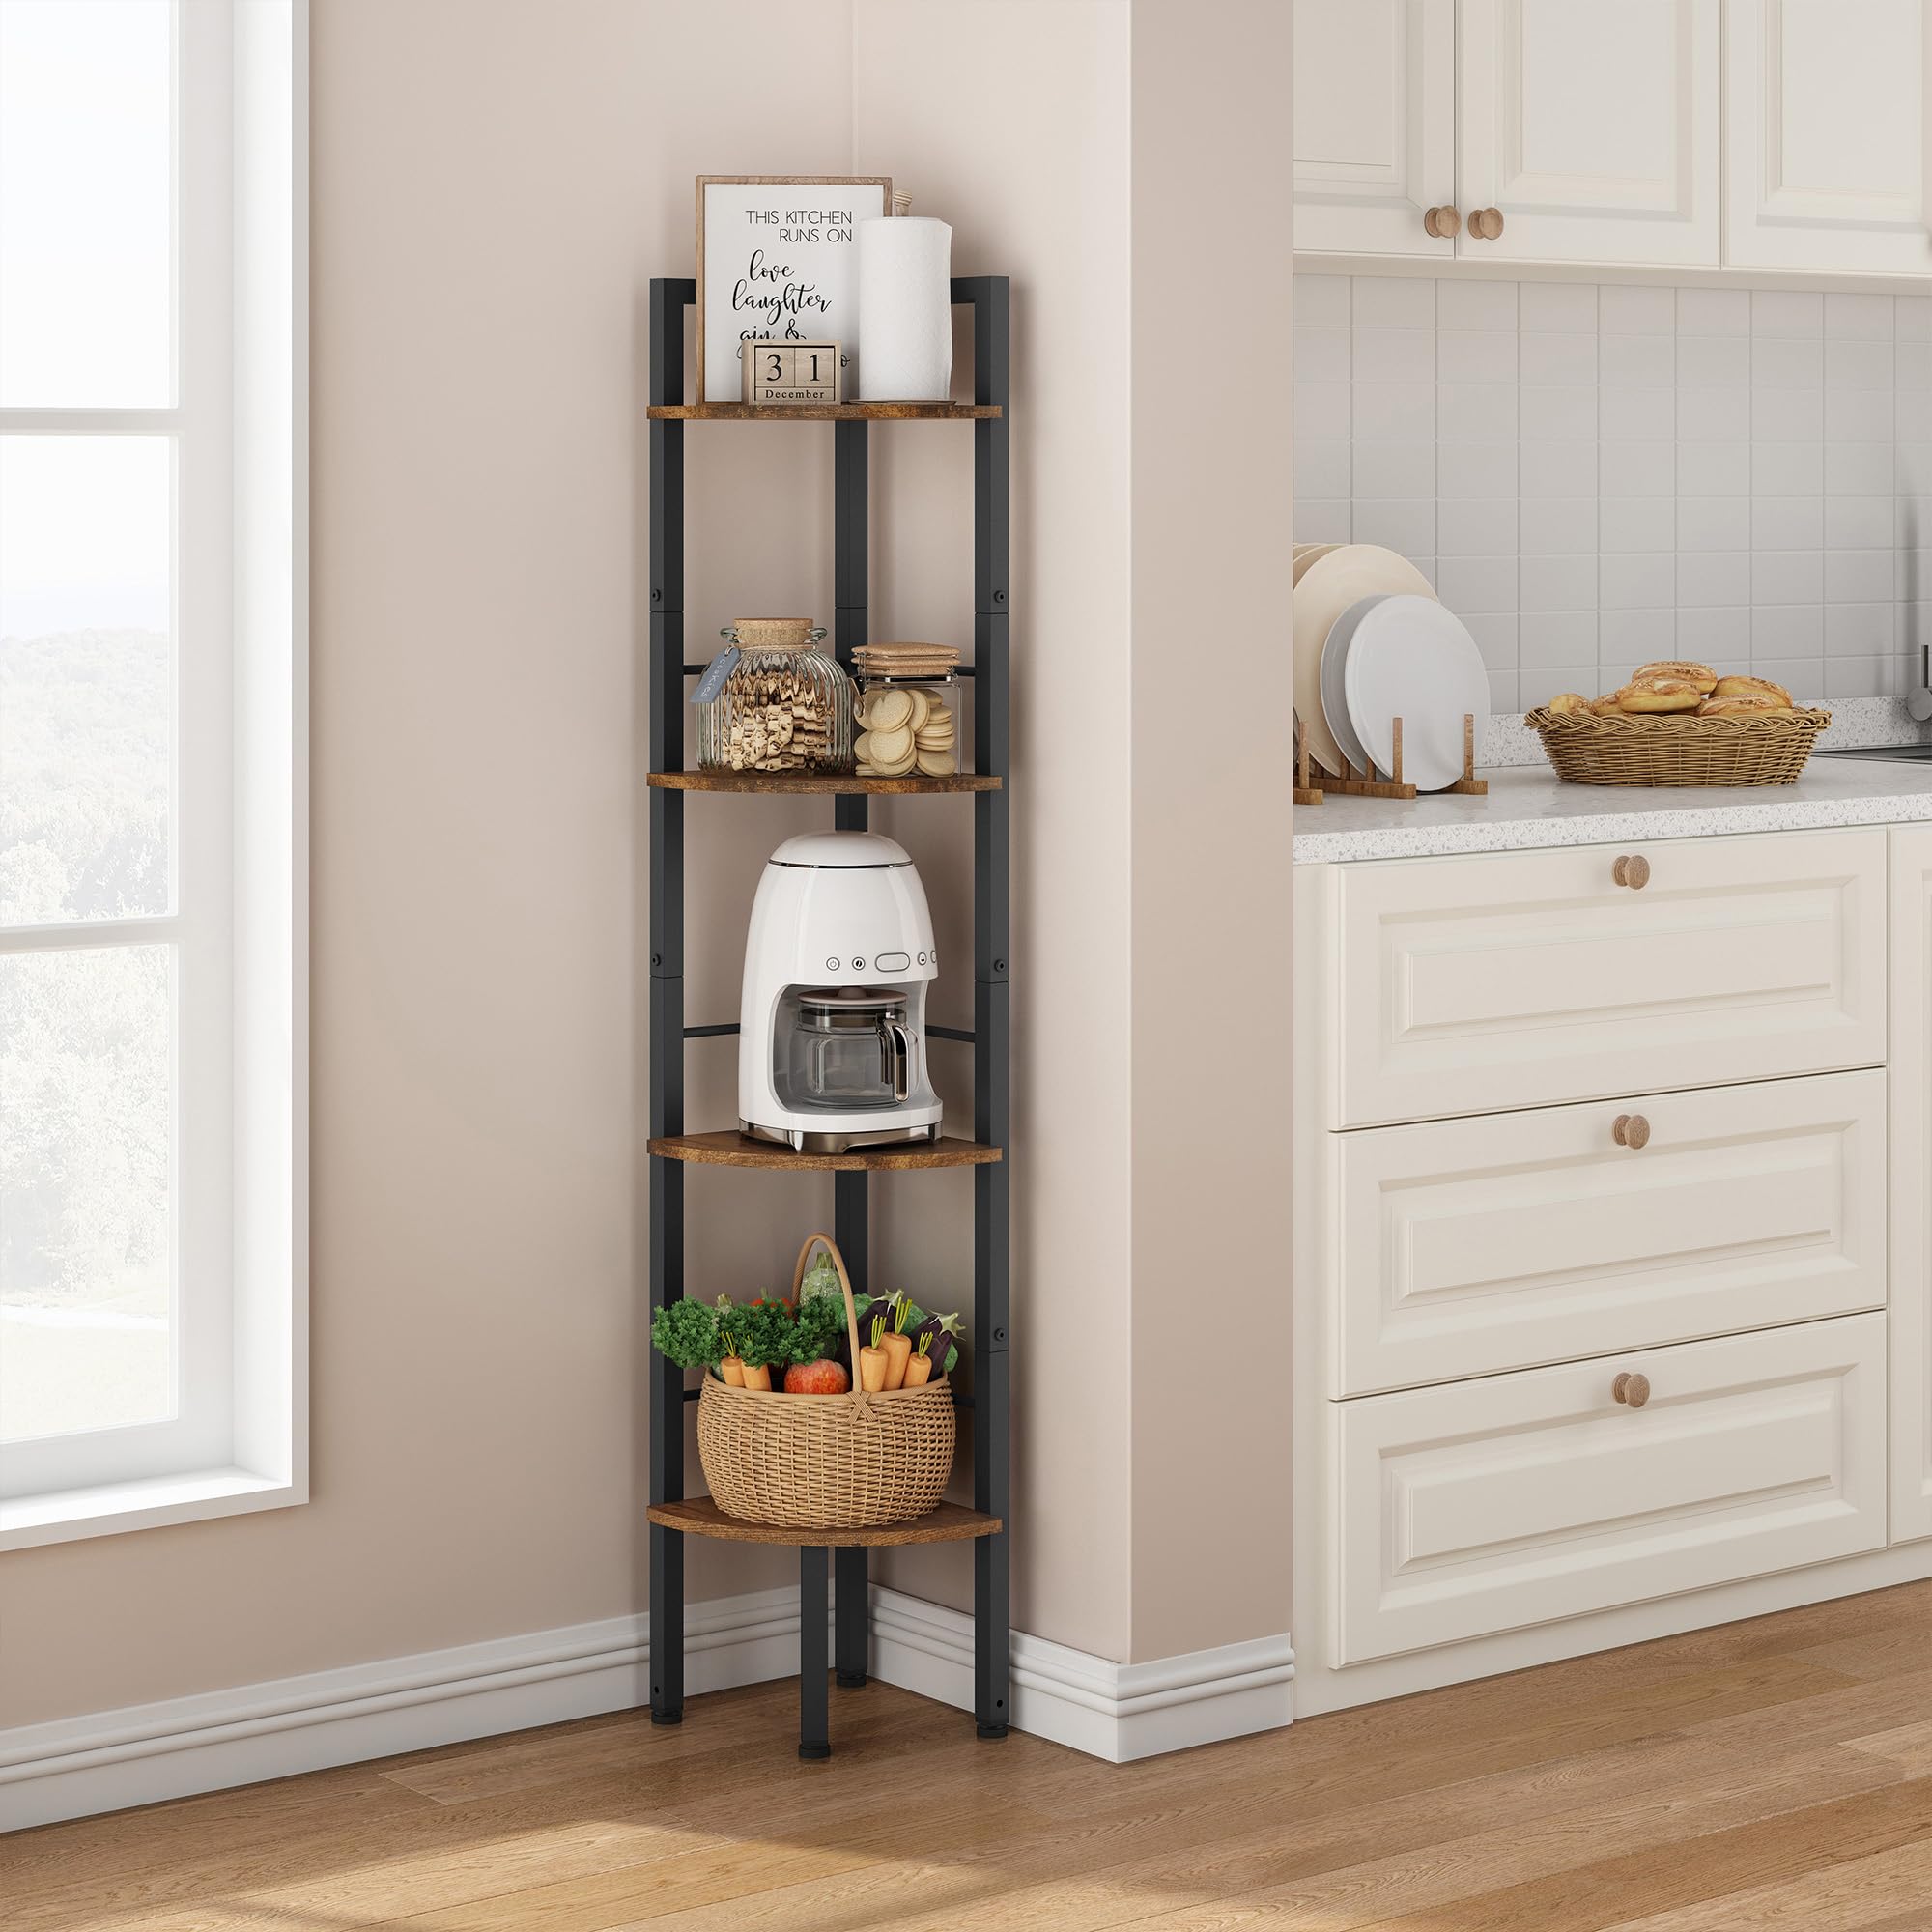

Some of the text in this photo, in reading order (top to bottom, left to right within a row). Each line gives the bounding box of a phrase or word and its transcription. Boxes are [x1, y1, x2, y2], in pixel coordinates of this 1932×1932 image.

[745, 210, 852, 225] THIS KITCHEN
[779, 228, 852, 243] RUNS ON
[749, 249, 795, 282] love
[732, 278, 832, 326] laughter
[765, 389, 825, 399] December
